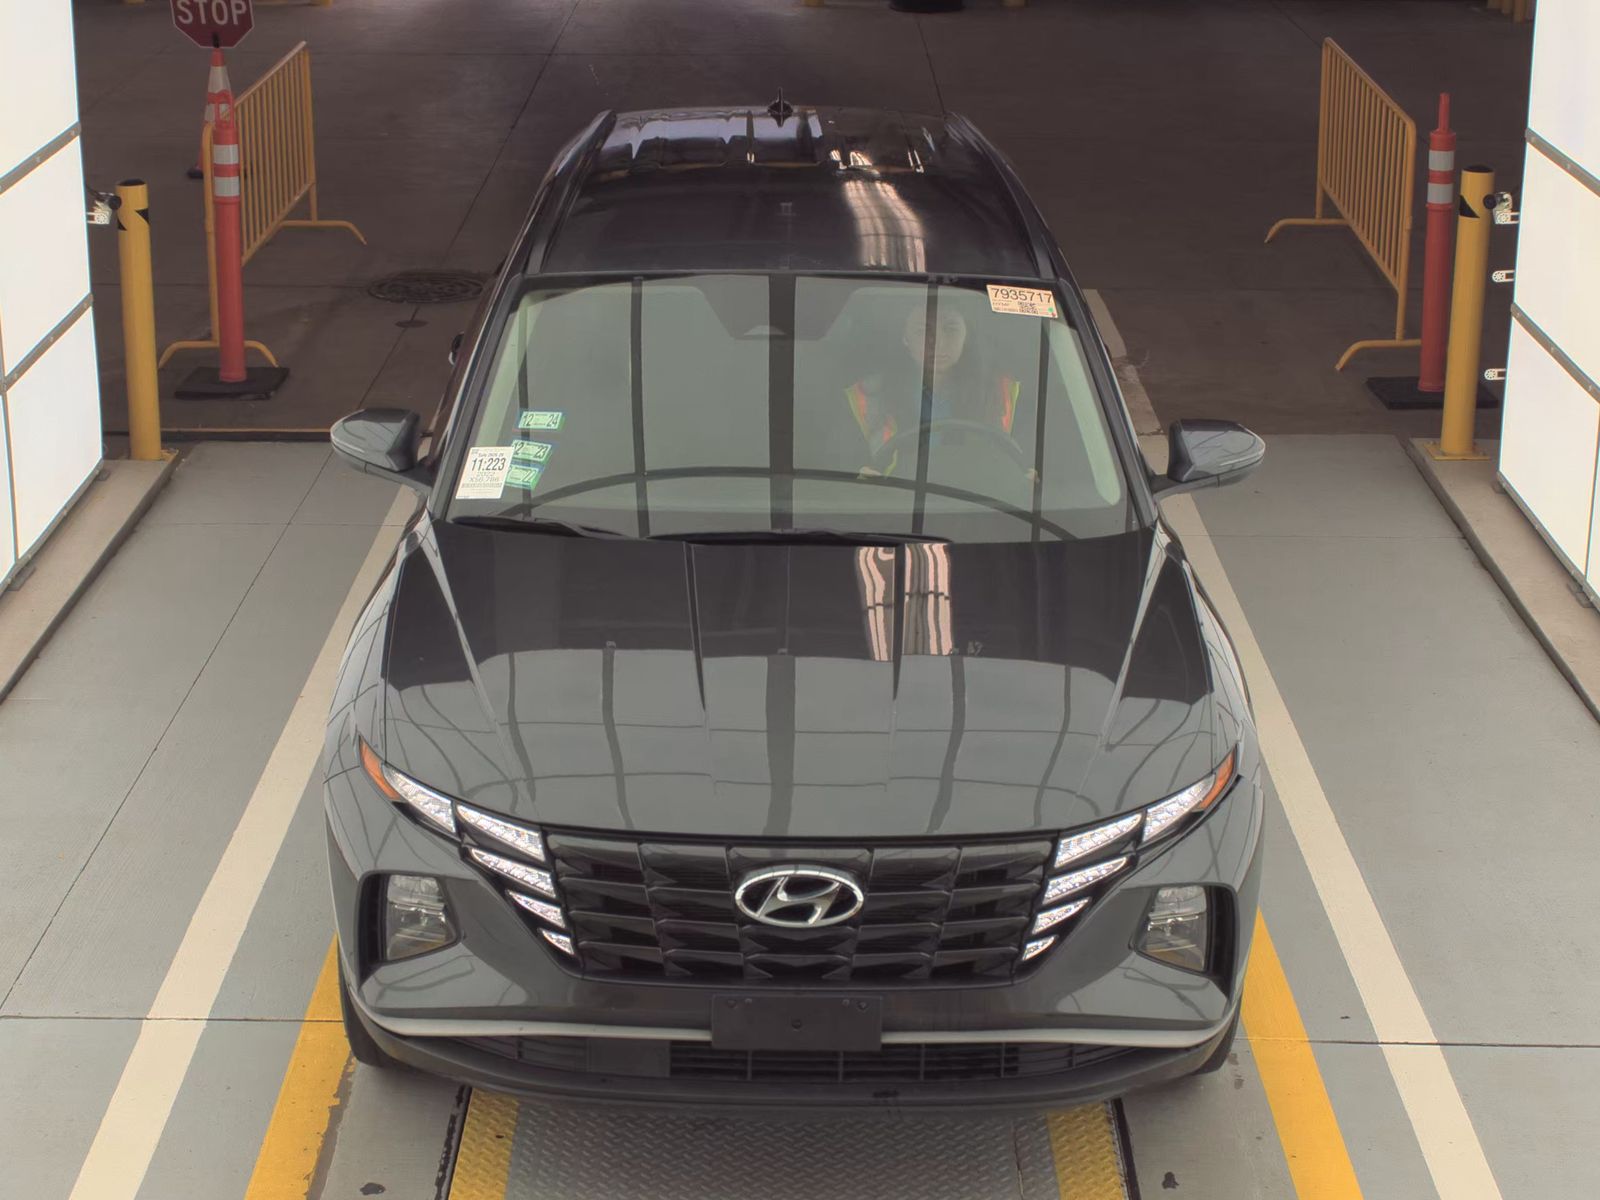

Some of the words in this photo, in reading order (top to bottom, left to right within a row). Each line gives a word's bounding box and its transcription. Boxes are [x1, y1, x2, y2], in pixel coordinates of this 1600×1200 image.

[176, 0, 247, 25] STOP
[991, 287, 1052, 304] 7935717
[523, 413, 534, 427] 12
[546, 413, 560, 427] 24
[533, 444, 548, 459] 23
